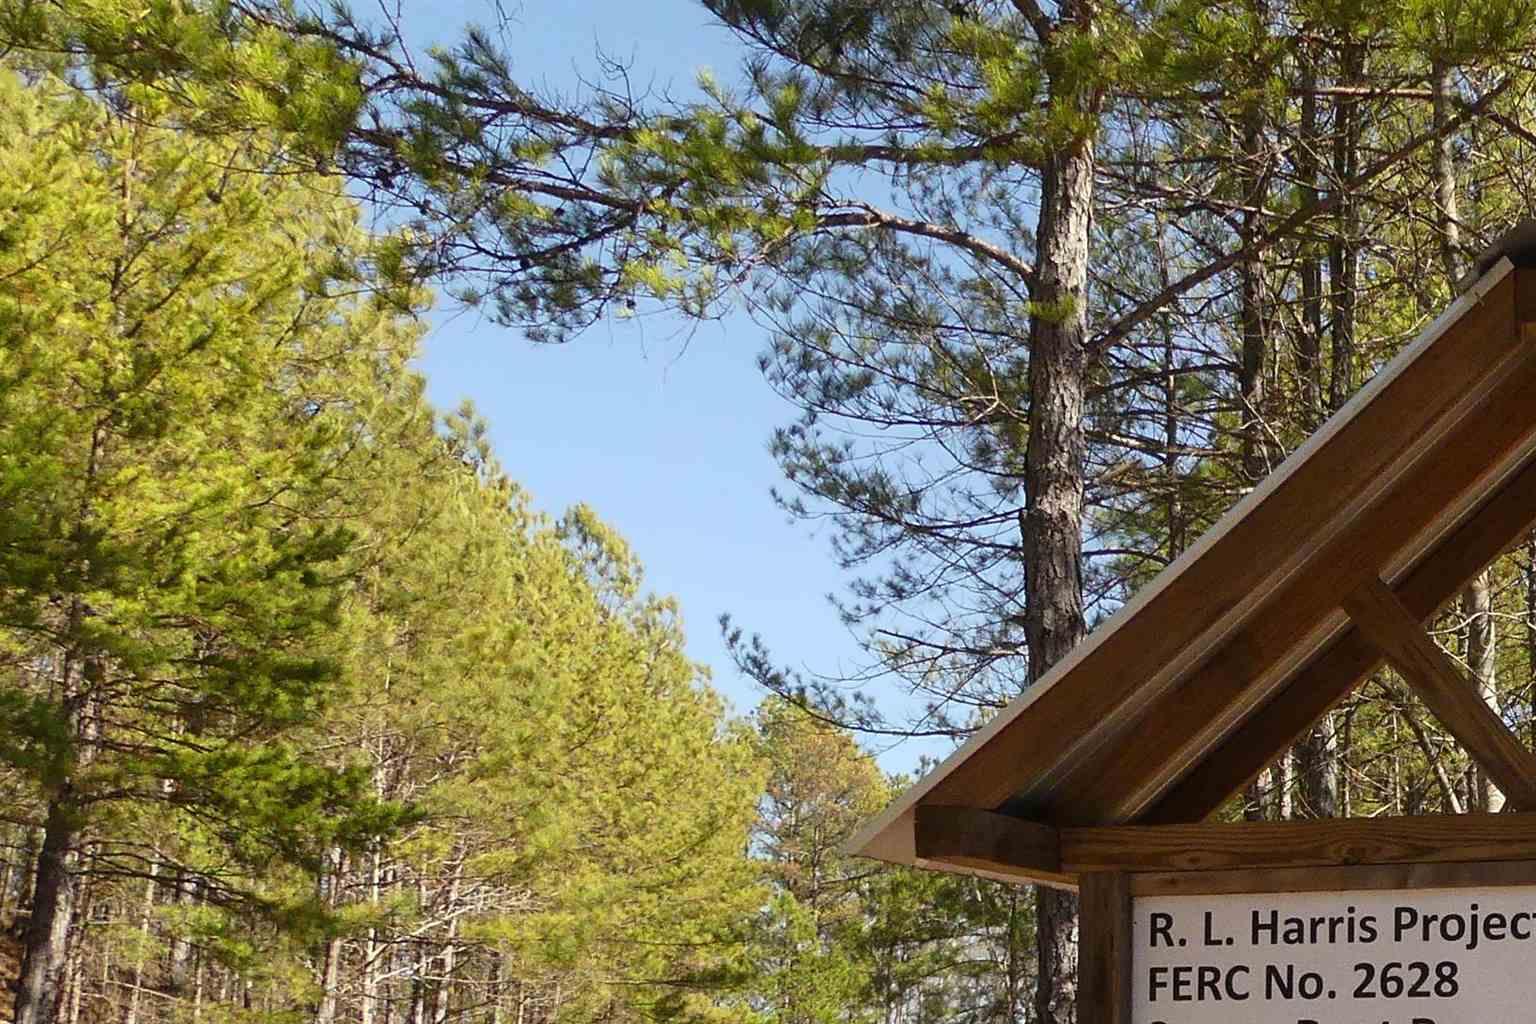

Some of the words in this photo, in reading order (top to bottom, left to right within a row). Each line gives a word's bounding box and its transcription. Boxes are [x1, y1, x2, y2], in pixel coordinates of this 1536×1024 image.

[1150, 913, 1186, 947] R.
[1204, 912, 1234, 946] L.
[1252, 906, 1377, 945] Harris
[1149, 965, 1250, 1002] FERC
[1265, 964, 1336, 1000] No.
[1353, 961, 1459, 998] 2628
